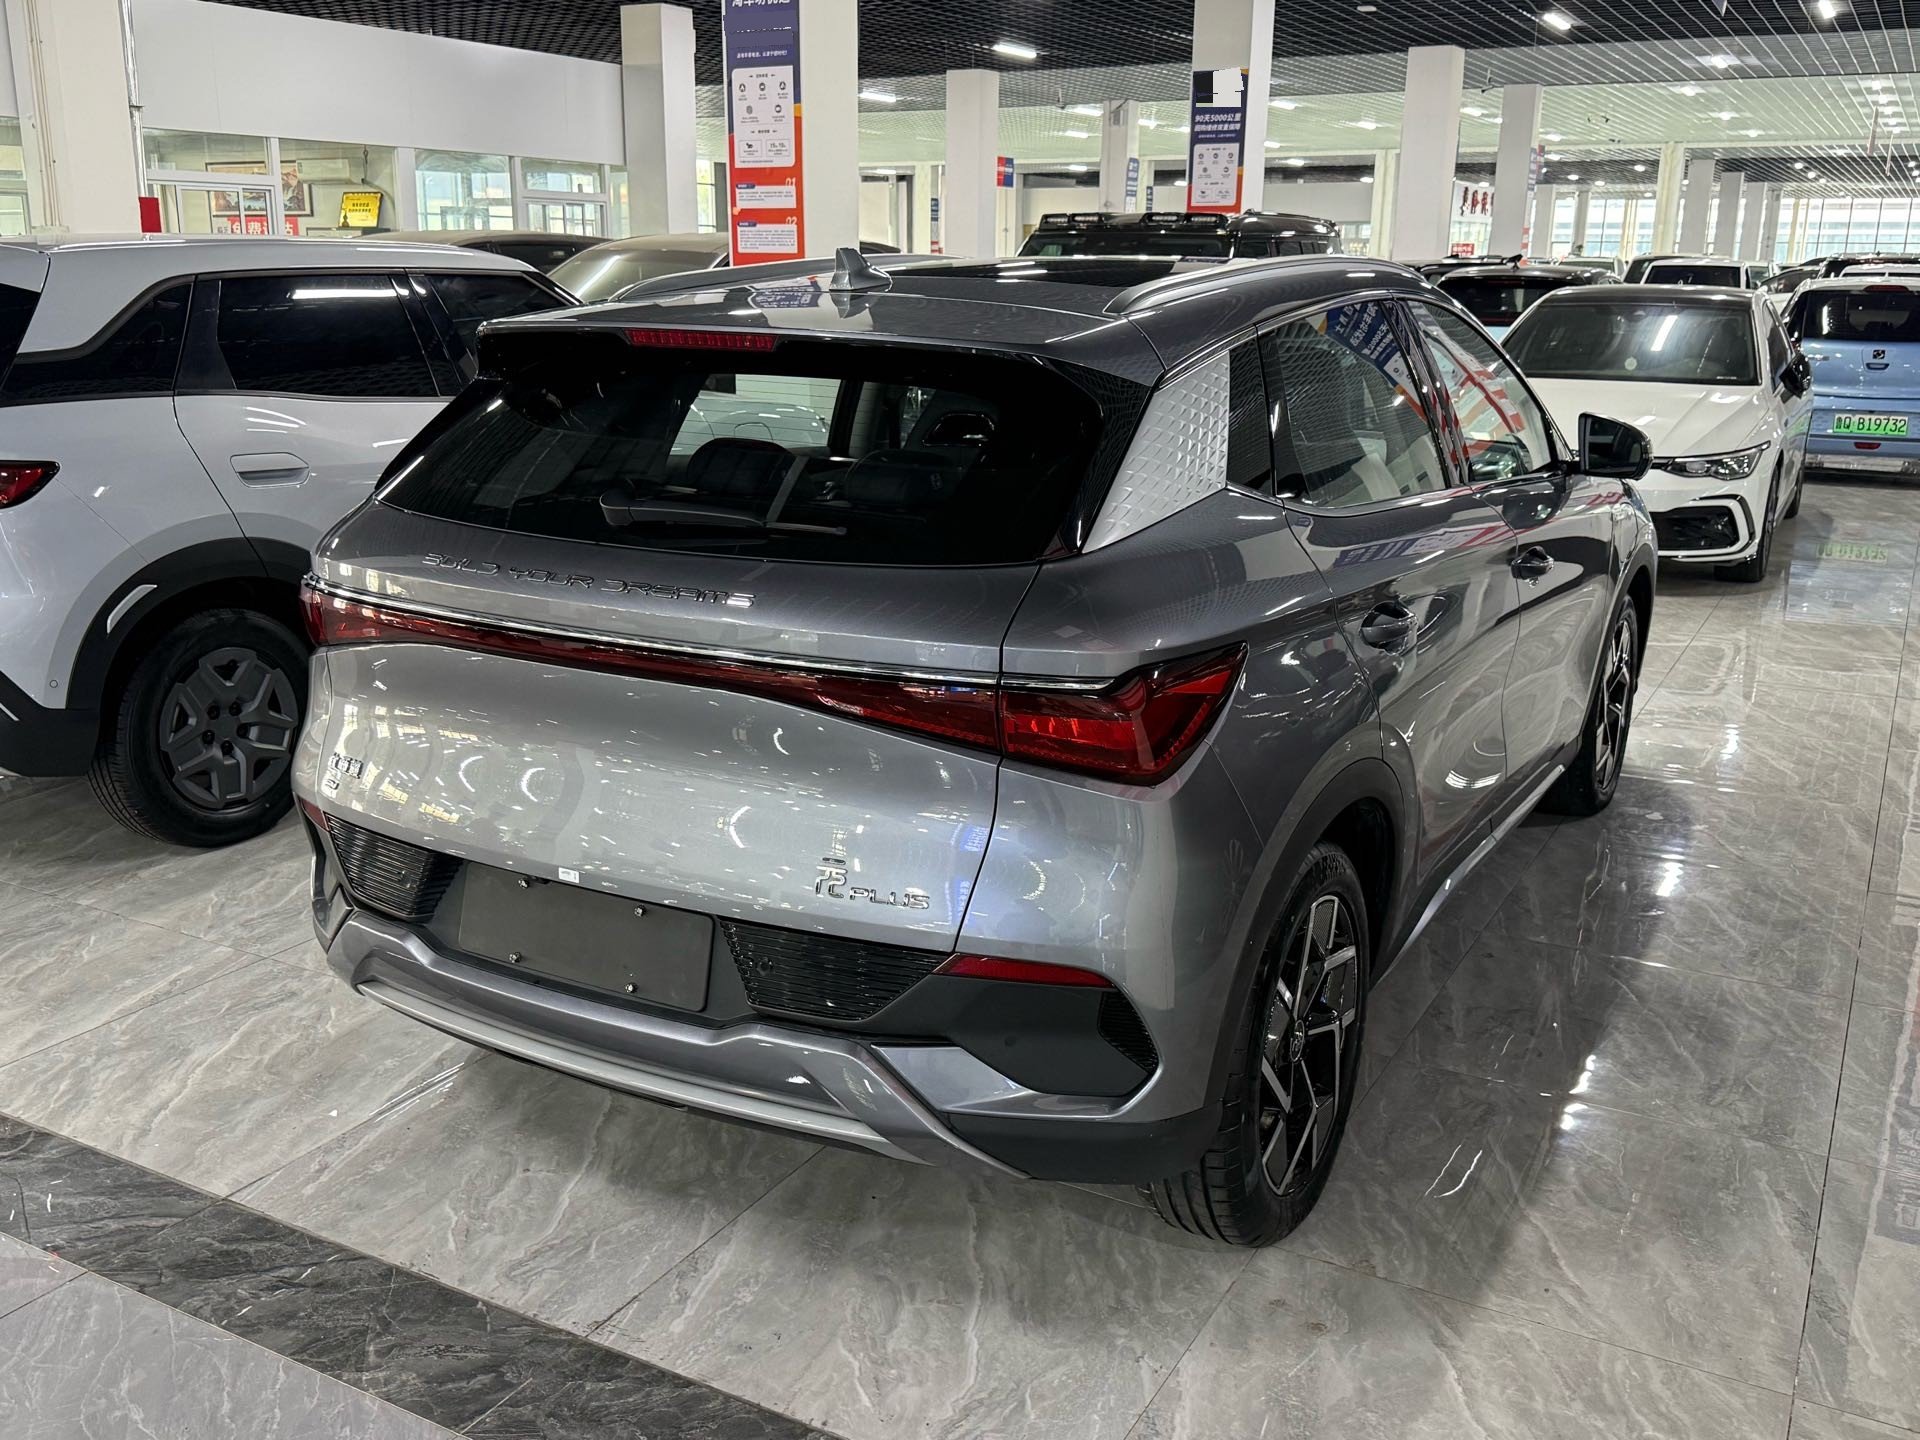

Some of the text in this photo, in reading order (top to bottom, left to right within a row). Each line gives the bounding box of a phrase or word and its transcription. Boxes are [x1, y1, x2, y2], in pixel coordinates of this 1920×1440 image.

[1856, 417, 1907, 433] B19732
[422, 552, 756, 609] BUILD YOUR DREAMS
[849, 886, 930, 910] PLUS
